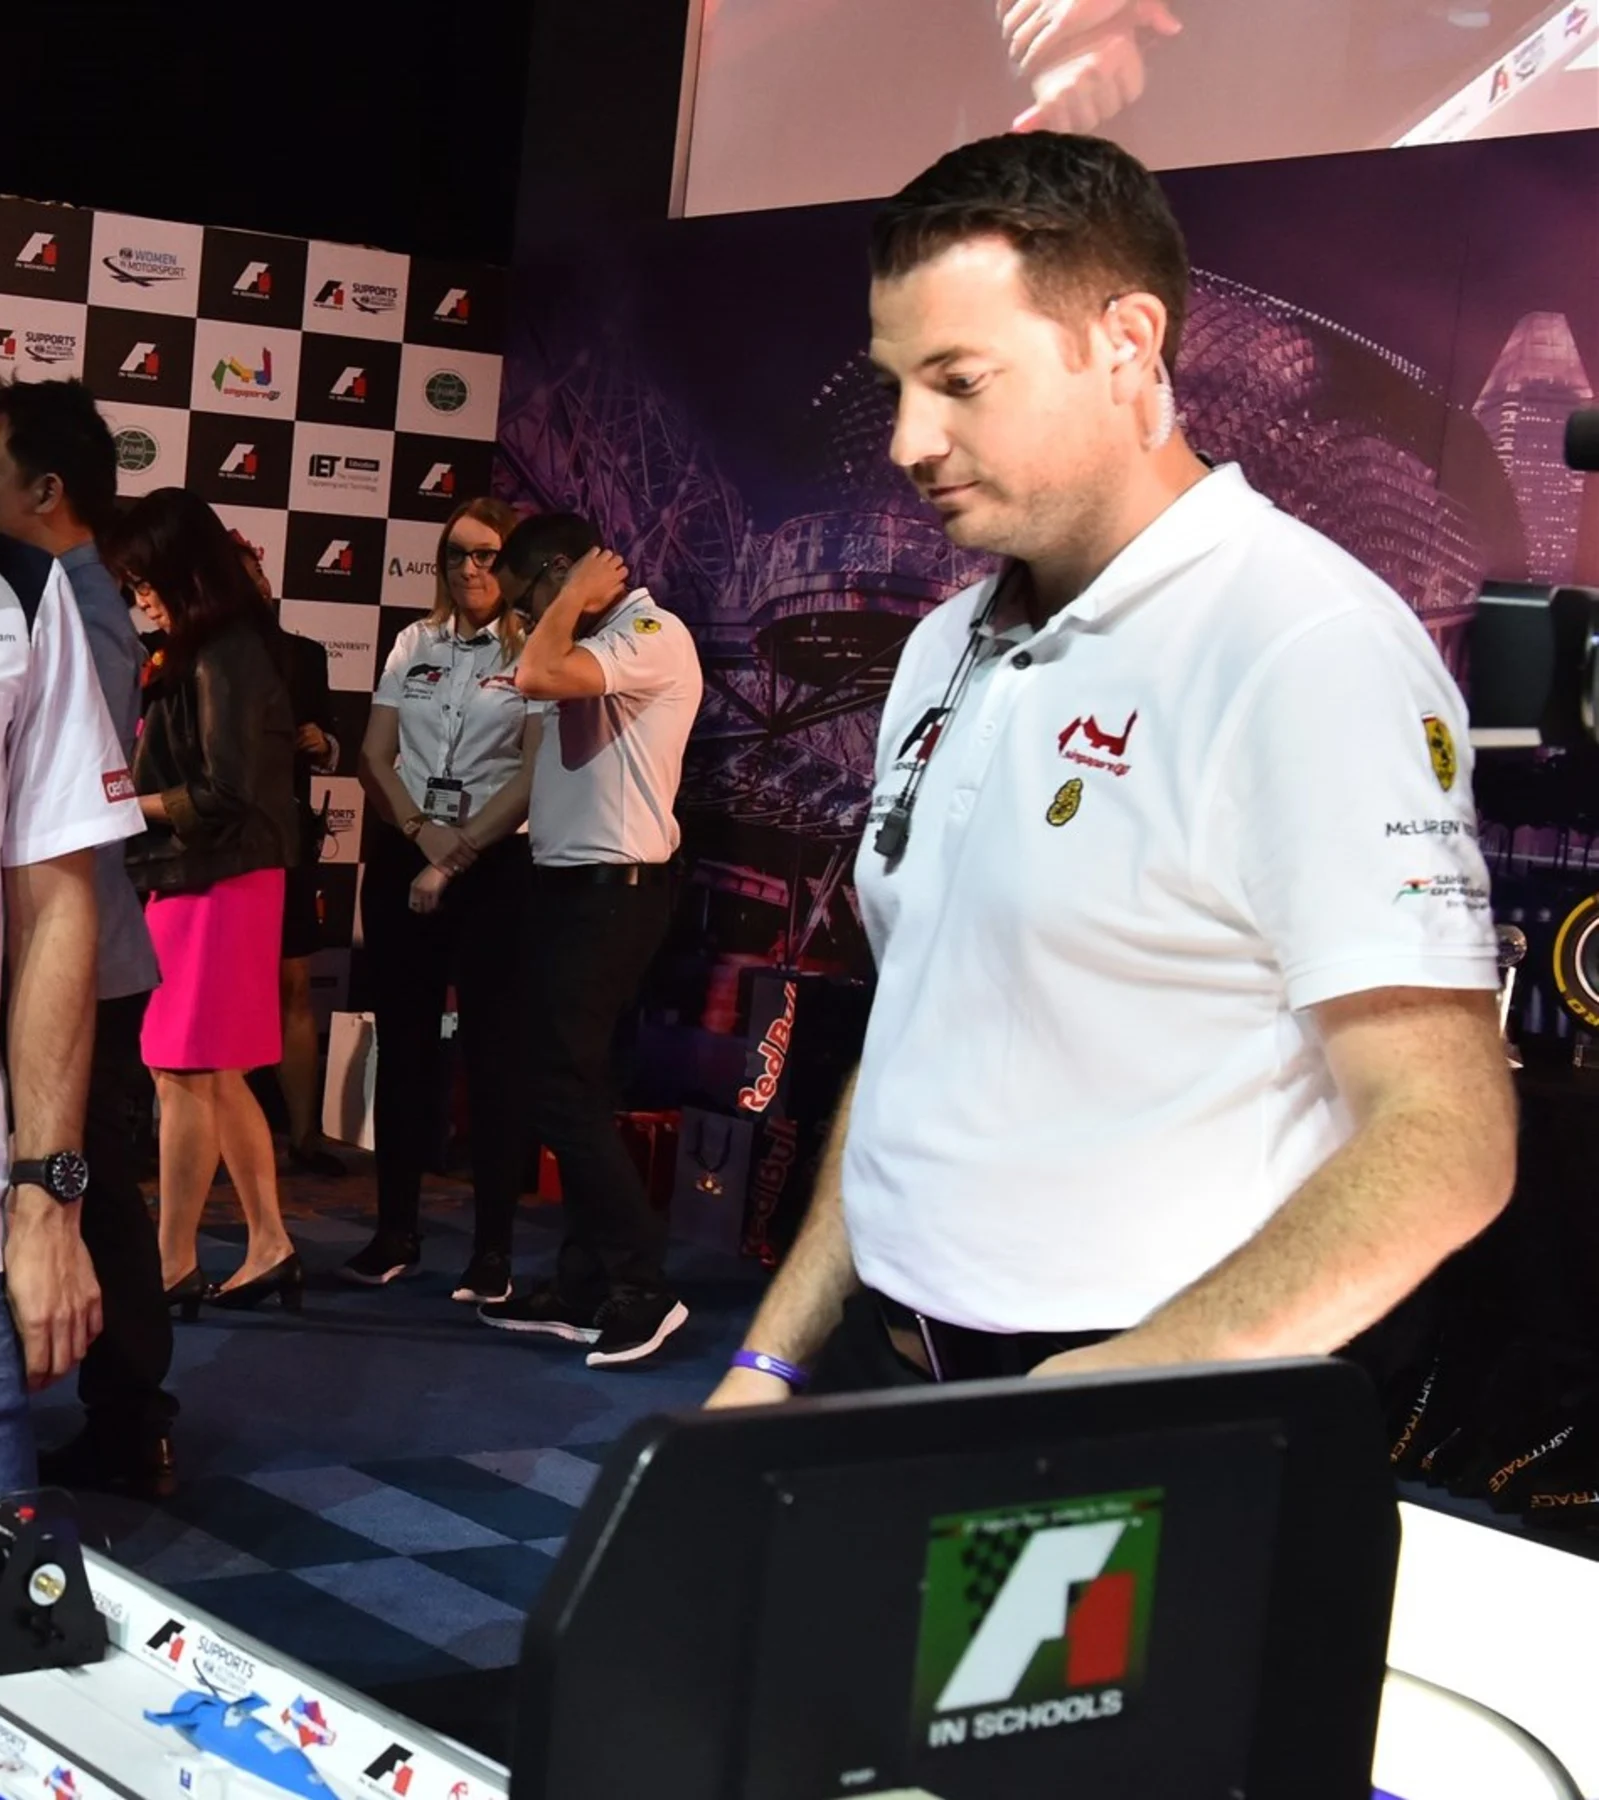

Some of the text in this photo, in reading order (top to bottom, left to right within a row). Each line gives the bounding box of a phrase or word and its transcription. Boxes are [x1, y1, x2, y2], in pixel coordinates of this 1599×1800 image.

[134, 249, 177, 264] WOMEN
[127, 260, 185, 278] MOTORSPORT
[352, 282, 397, 299] SUPPORTS
[25, 331, 76, 348] SUPPORTS
[309, 454, 342, 478] IET
[736, 1041, 787, 1113] Red
[197, 1634, 256, 1680] SUPPORTS
[927, 1688, 1125, 1749] IN SCHOOLS
